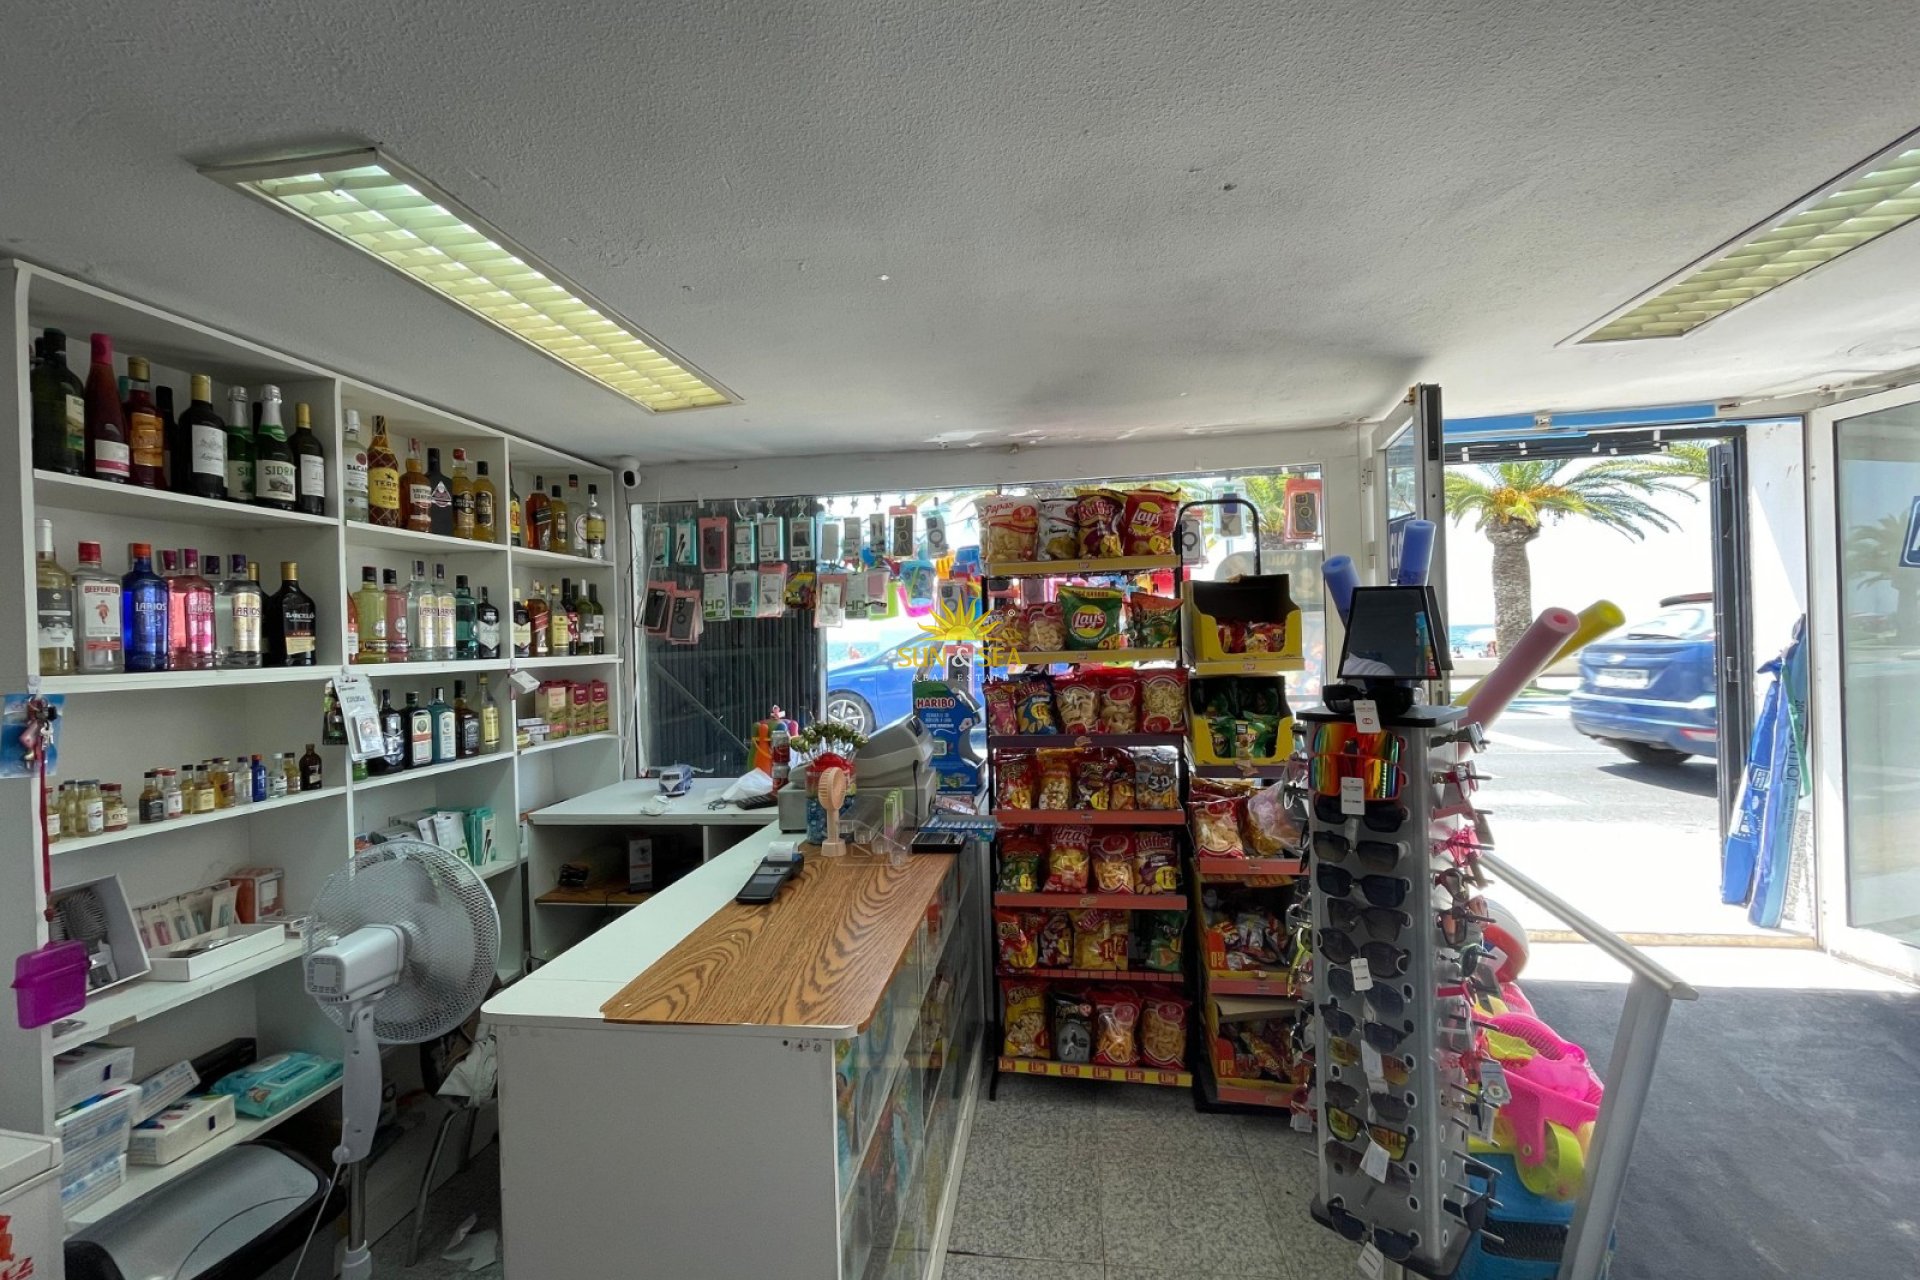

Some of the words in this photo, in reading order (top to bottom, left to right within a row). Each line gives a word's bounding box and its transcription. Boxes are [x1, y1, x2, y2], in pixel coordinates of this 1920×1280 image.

[84, 585, 119, 594] BEEFEATER
[135, 602, 167, 612] LARIOS
[705, 599, 726, 611] HD
[846, 600, 865, 611] HD
[917, 698, 955, 708] HARIBO
